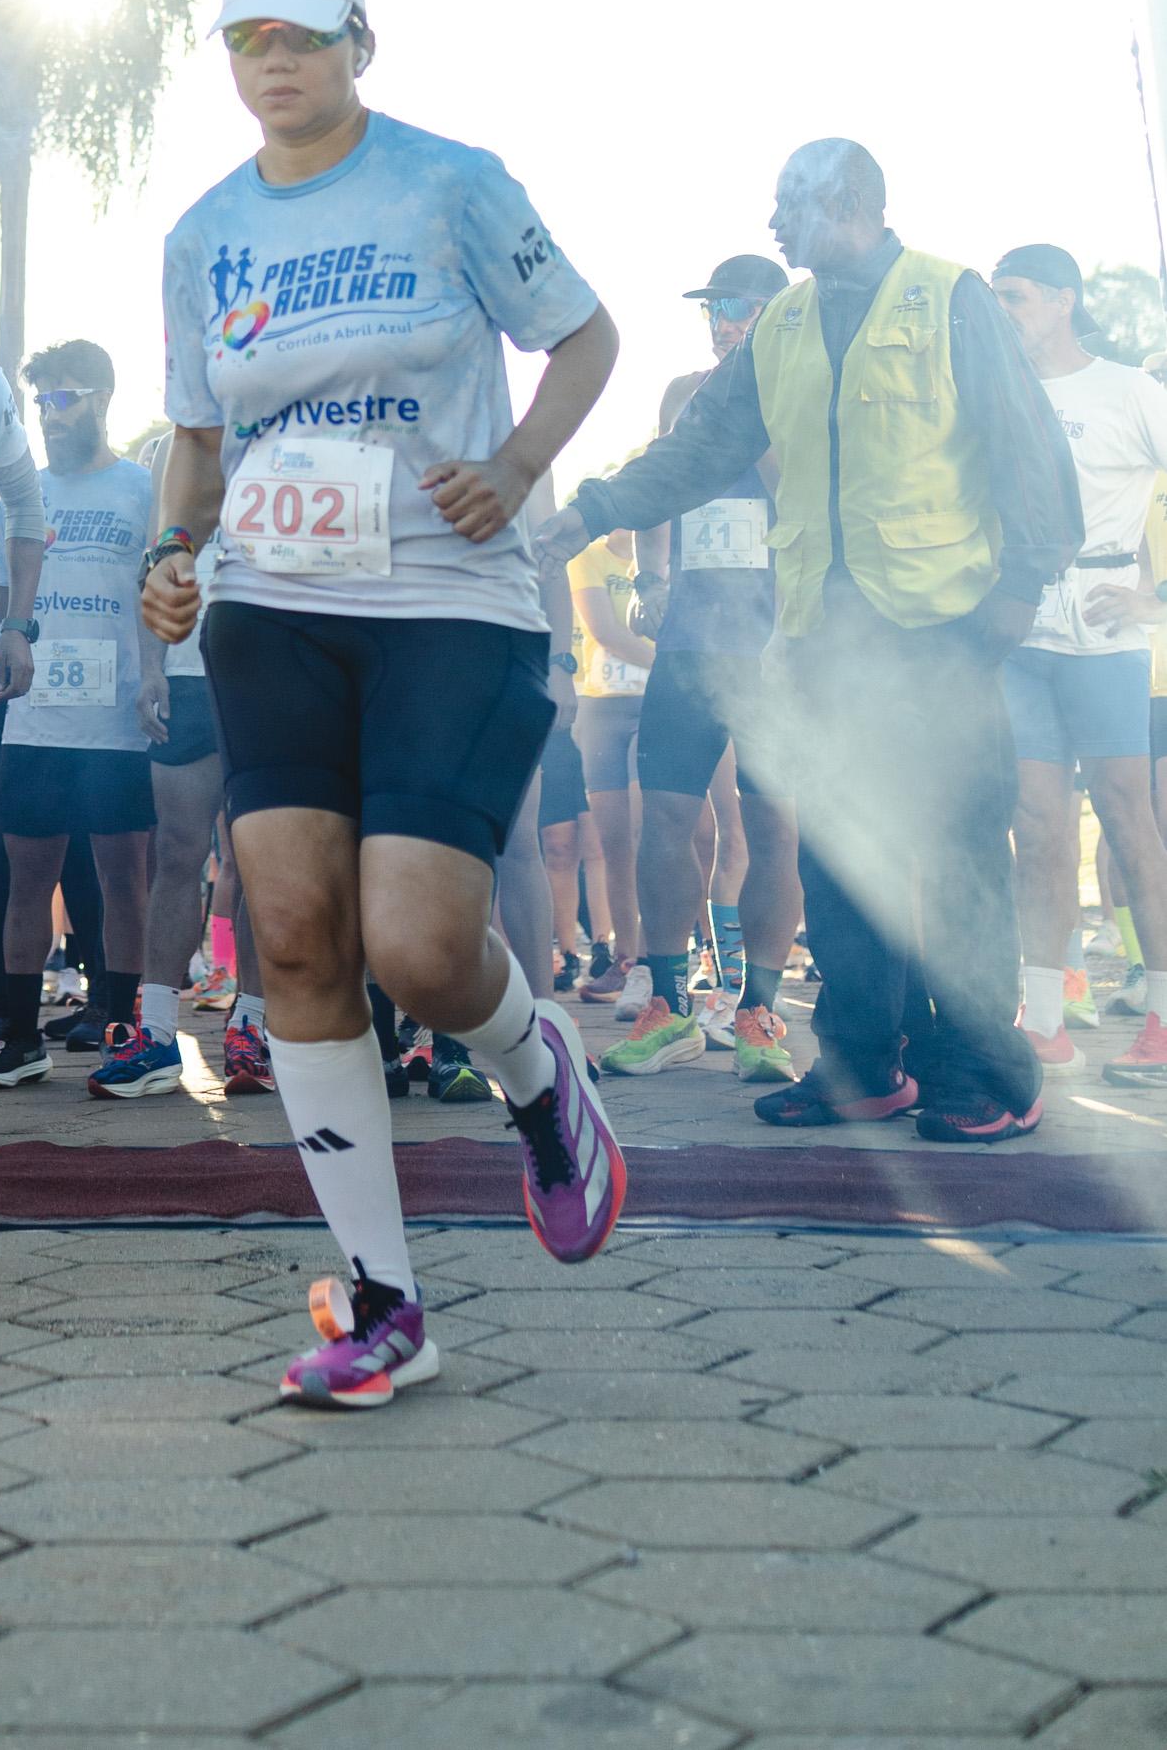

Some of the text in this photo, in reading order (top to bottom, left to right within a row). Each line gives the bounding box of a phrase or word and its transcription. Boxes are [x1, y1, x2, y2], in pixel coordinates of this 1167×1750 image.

[261, 244, 413, 293] PASSOS que
[272, 272, 417, 318] ACOLHEM
[276, 322, 413, 352] Corrida Abril Azul
[51, 510, 115, 526] PASSOS
[237, 483, 346, 537] 202
[57, 526, 133, 547] ACOLHEM
[696, 522, 730, 549] 41
[34, 591, 121, 615] sylvestre
[48, 661, 84, 687] 58
[602, 663, 626, 680] 91
